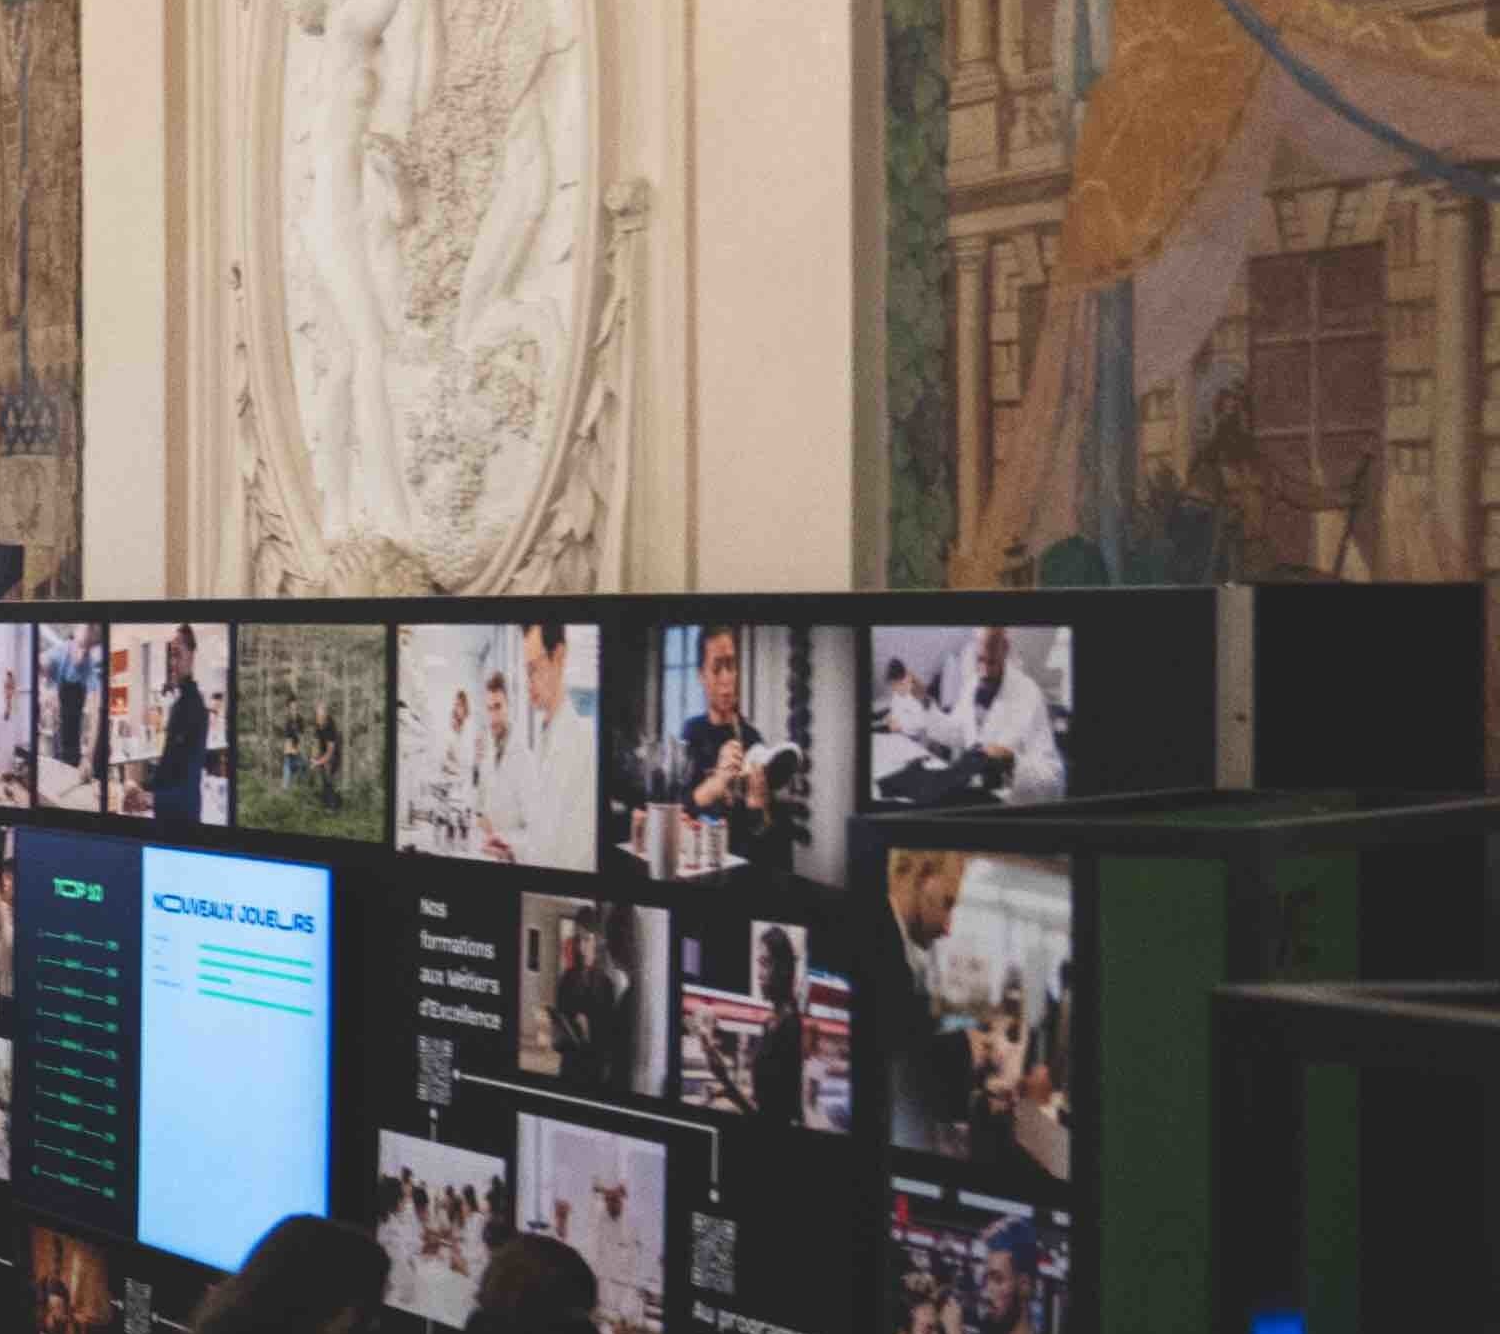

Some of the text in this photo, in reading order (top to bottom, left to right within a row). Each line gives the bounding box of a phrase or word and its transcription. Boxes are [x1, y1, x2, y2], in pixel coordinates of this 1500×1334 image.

[52, 876, 86, 899] TOP
[153, 892, 316, 935] NOUVEAUX JOUEURS
[420, 897, 449, 919] Nos
[419, 929, 496, 959] formations
[419, 966, 445, 986] aux
[692, 1300, 715, 1324] au
